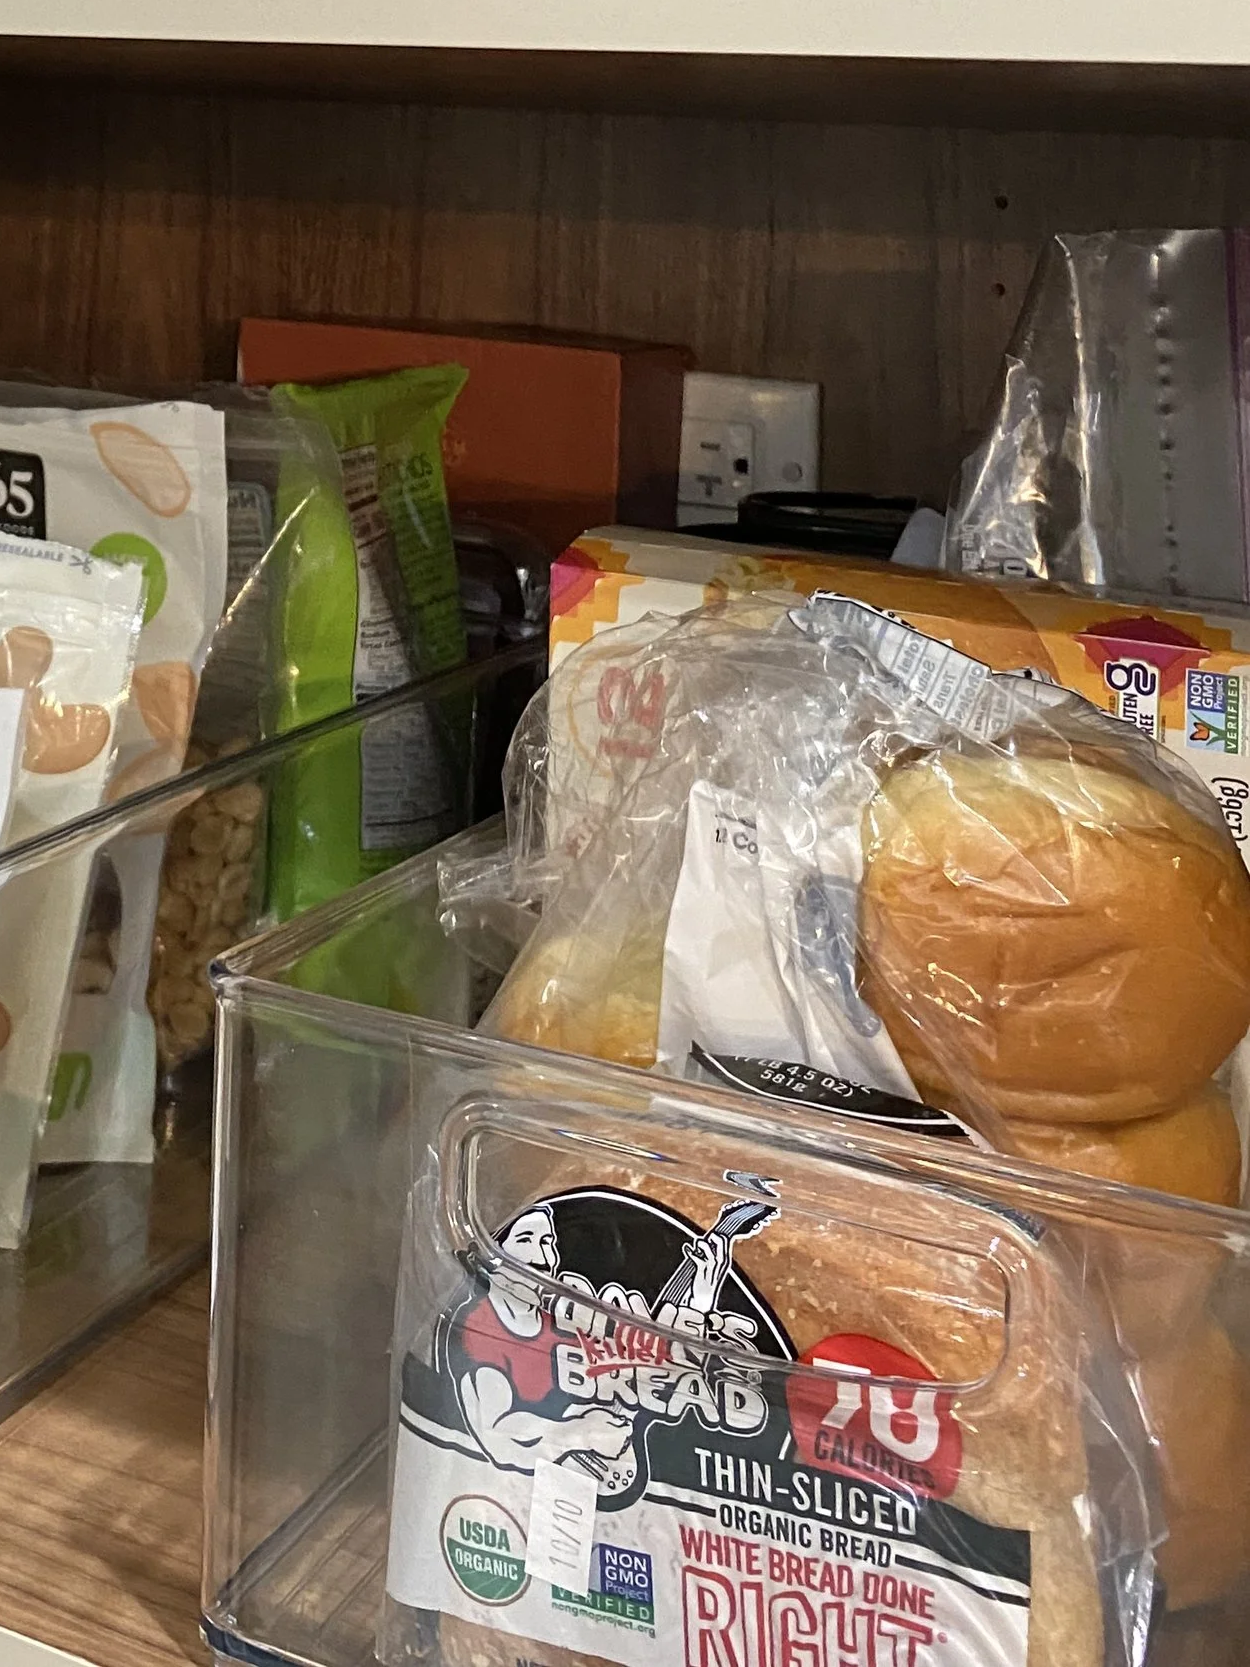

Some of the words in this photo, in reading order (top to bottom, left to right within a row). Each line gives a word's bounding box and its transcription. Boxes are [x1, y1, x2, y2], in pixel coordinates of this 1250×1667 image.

[1190, 673, 1202, 707] NON
[1202, 675, 1214, 708] GMO
[1214, 677, 1226, 710] Project
[1226, 678, 1239, 750] VERIFIED
[556, 1344, 768, 1429] BREAD
[814, 1429, 937, 1491] CALORIES
[694, 1447, 918, 1536] THIN-SLICED
[459, 1516, 511, 1553] USDA
[719, 1503, 812, 1549] ORGANIC
[820, 1527, 892, 1569] BREAD
[454, 1546, 519, 1582] ORGANIC
[604, 1565, 650, 1588] GMO
[605, 1549, 648, 1572] NON
[679, 1524, 762, 1577] WHITE
[769, 1548, 854, 1597] BREAD
[863, 1570, 935, 1621] DONE
[558, 1587, 651, 1621] VERIFIED
[605, 1581, 650, 1603] Project
[682, 1564, 933, 1667] RIGHT
